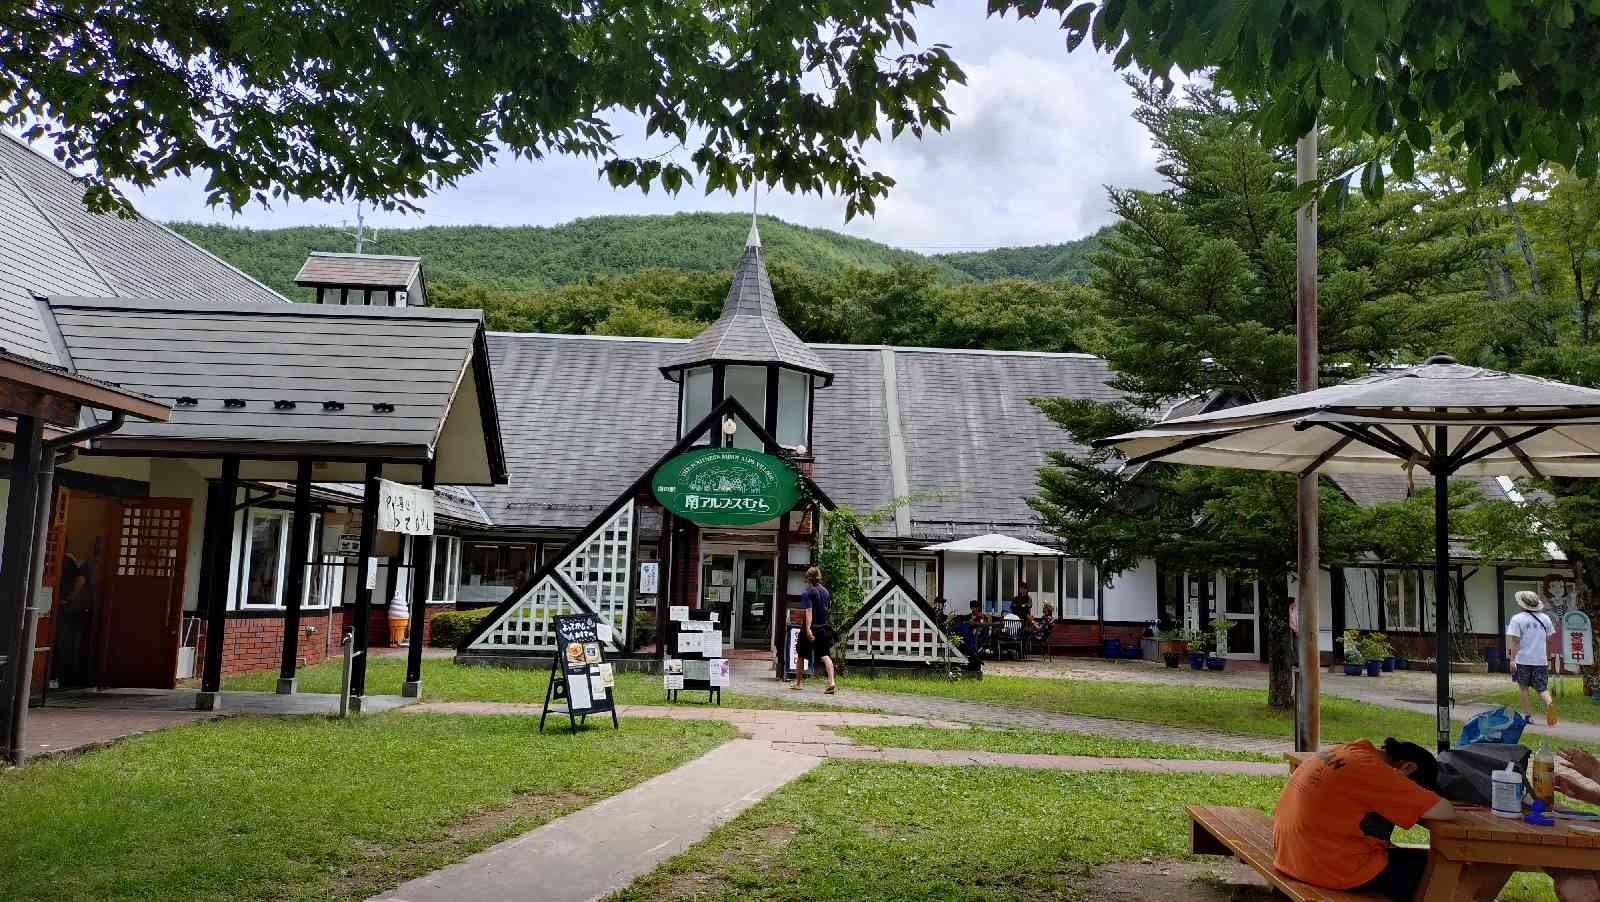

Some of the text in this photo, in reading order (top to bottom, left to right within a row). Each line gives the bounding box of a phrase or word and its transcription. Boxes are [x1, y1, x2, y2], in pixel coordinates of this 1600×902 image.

[685, 494, 770, 512] 南アルプスむら
[1570, 631, 1585, 662] 営業中
